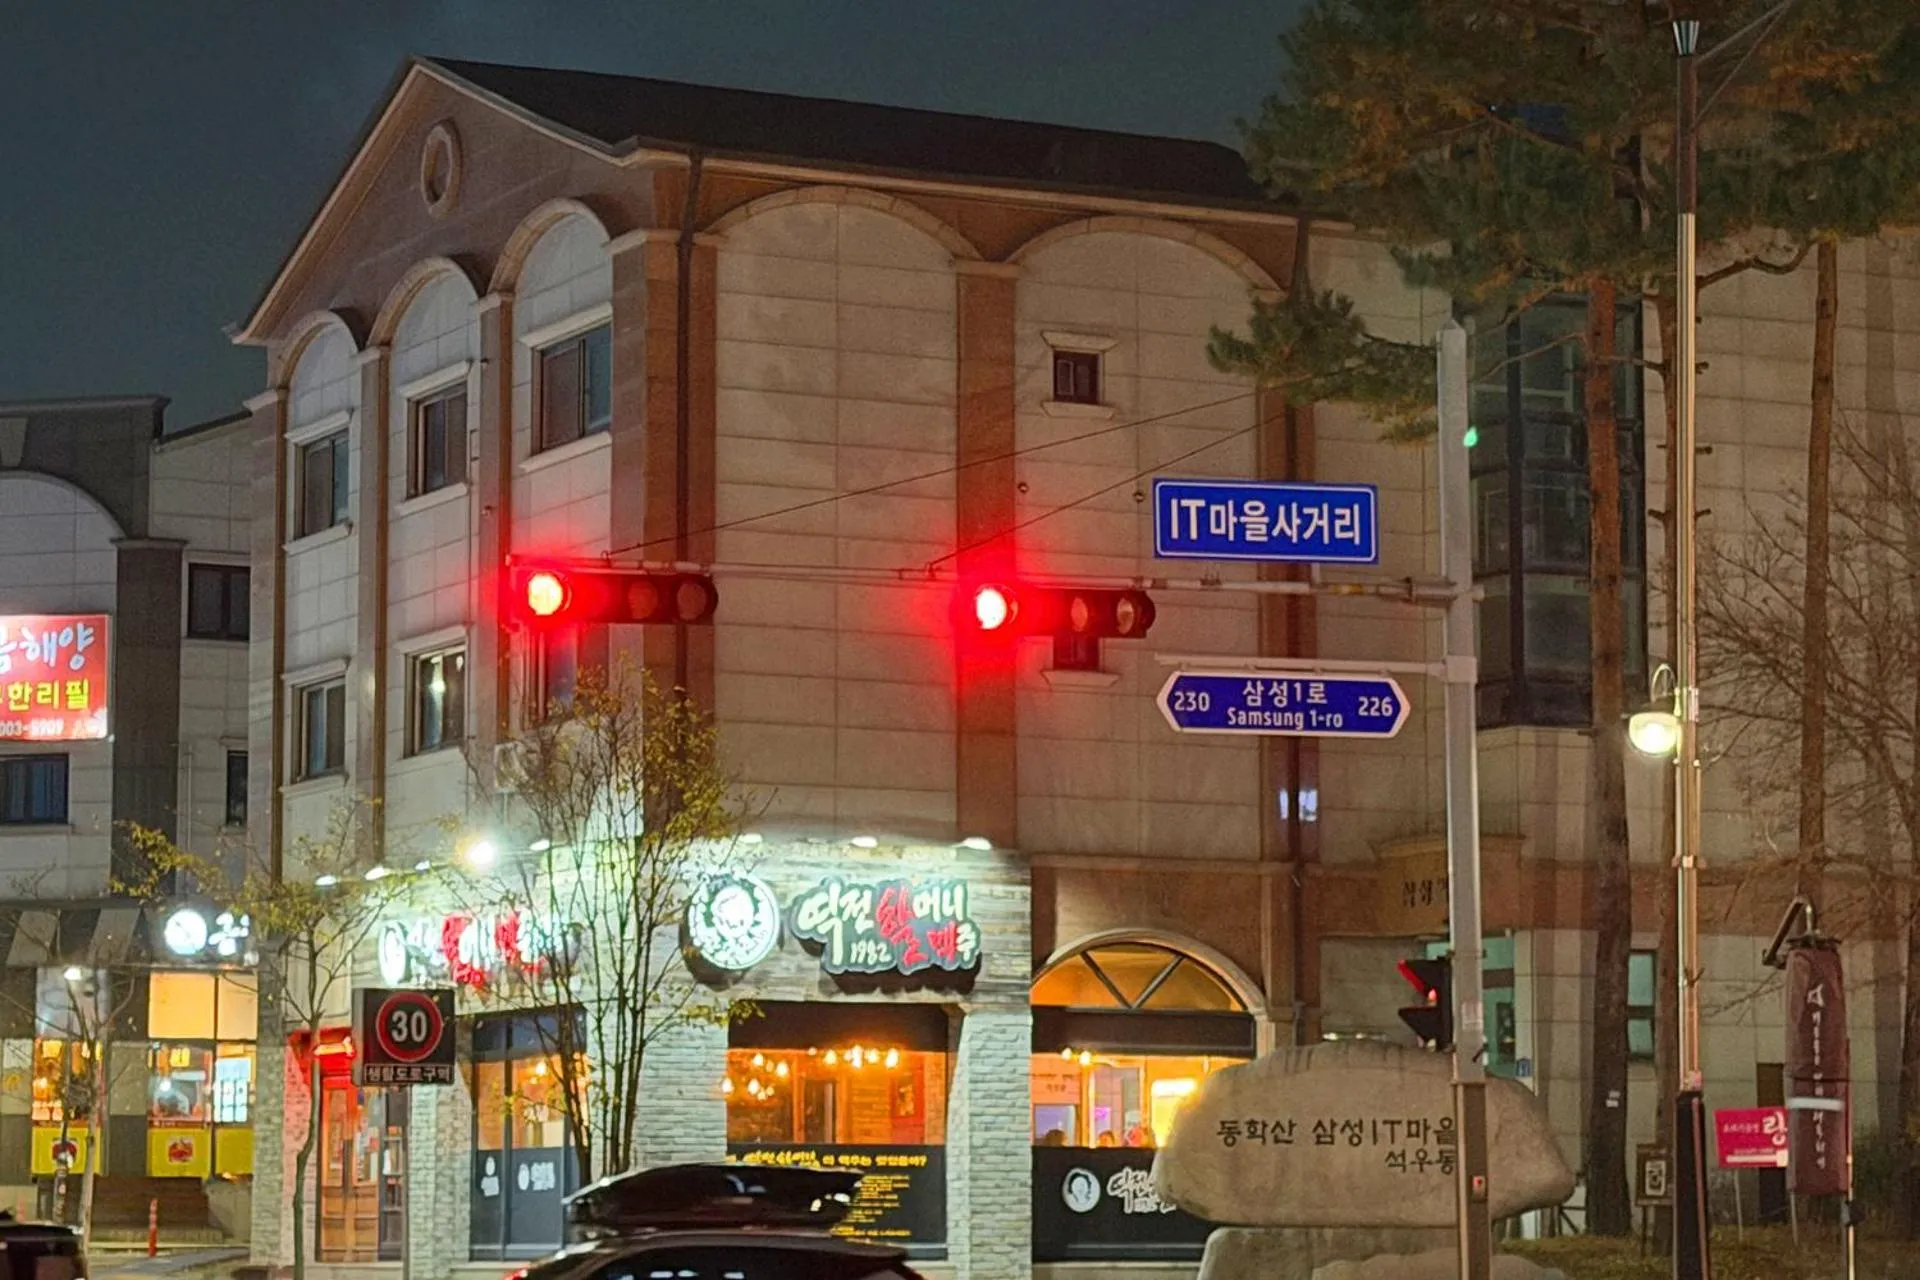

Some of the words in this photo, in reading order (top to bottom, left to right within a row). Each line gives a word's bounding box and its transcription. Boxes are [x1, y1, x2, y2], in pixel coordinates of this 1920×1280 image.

[1170, 498, 1361, 545] IT마을사거리
[0, 678, 90, 712] 한리필
[1173, 691, 1211, 712] 230
[1242, 680, 1329, 707] 삼성1로
[1357, 696, 1394, 717] 226
[1226, 708, 1305, 731] Samsung
[1309, 711, 1344, 728] 1-ro
[849, 938, 892, 966] 1982
[391, 1009, 428, 1043] 30
[367, 1066, 451, 1083] 생활도로구역
[1216, 1117, 1298, 1148] 동학산
[1384, 1148, 1456, 1176] 석우동
